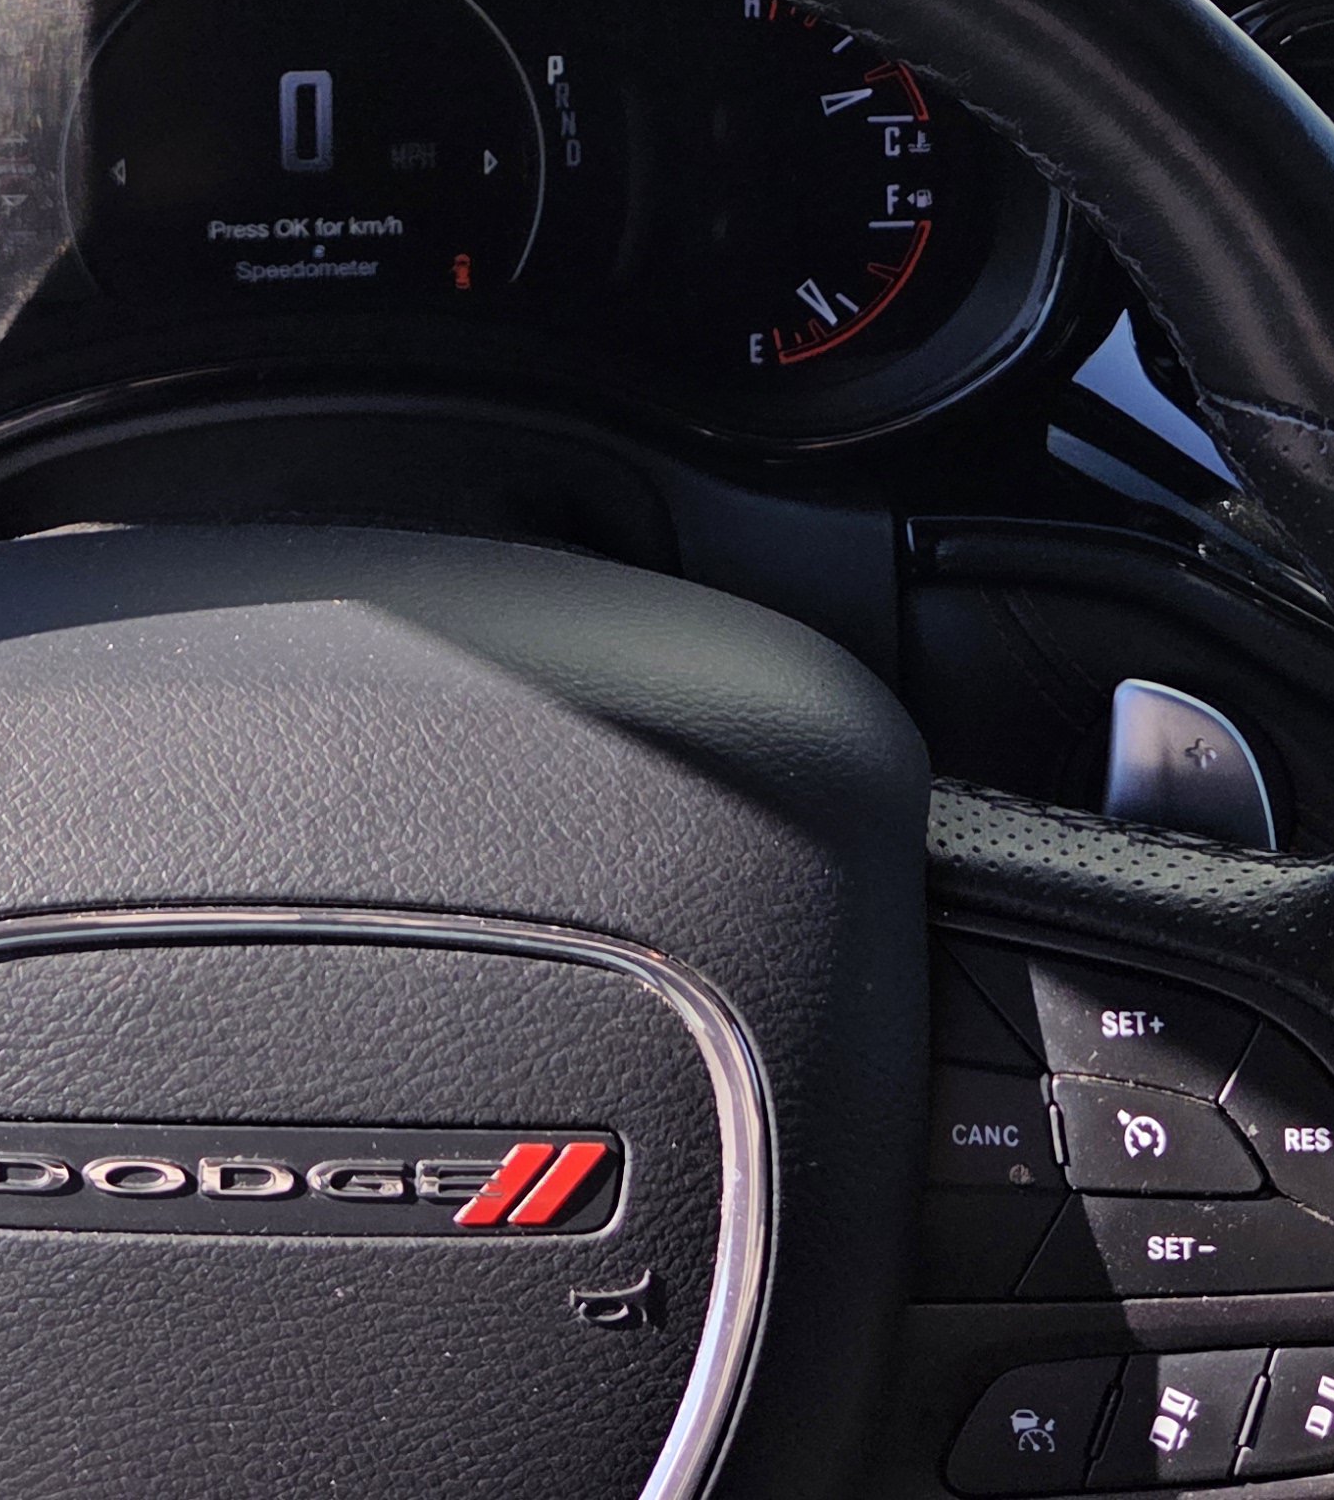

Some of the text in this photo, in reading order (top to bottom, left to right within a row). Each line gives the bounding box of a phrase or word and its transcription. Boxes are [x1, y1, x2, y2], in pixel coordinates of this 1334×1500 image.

[547, 55, 564, 85] P
[555, 82, 570, 109] R
[279, 69, 334, 171] 0
[884, 126, 901, 156] C
[886, 184, 900, 214] F
[208, 215, 403, 241] Press OK for km/h
[235, 259, 379, 282] Speedometer
[749, 333, 764, 363] E
[951, 1124, 1020, 1147] CANC
[1283, 1127, 1333, 1153] RES
